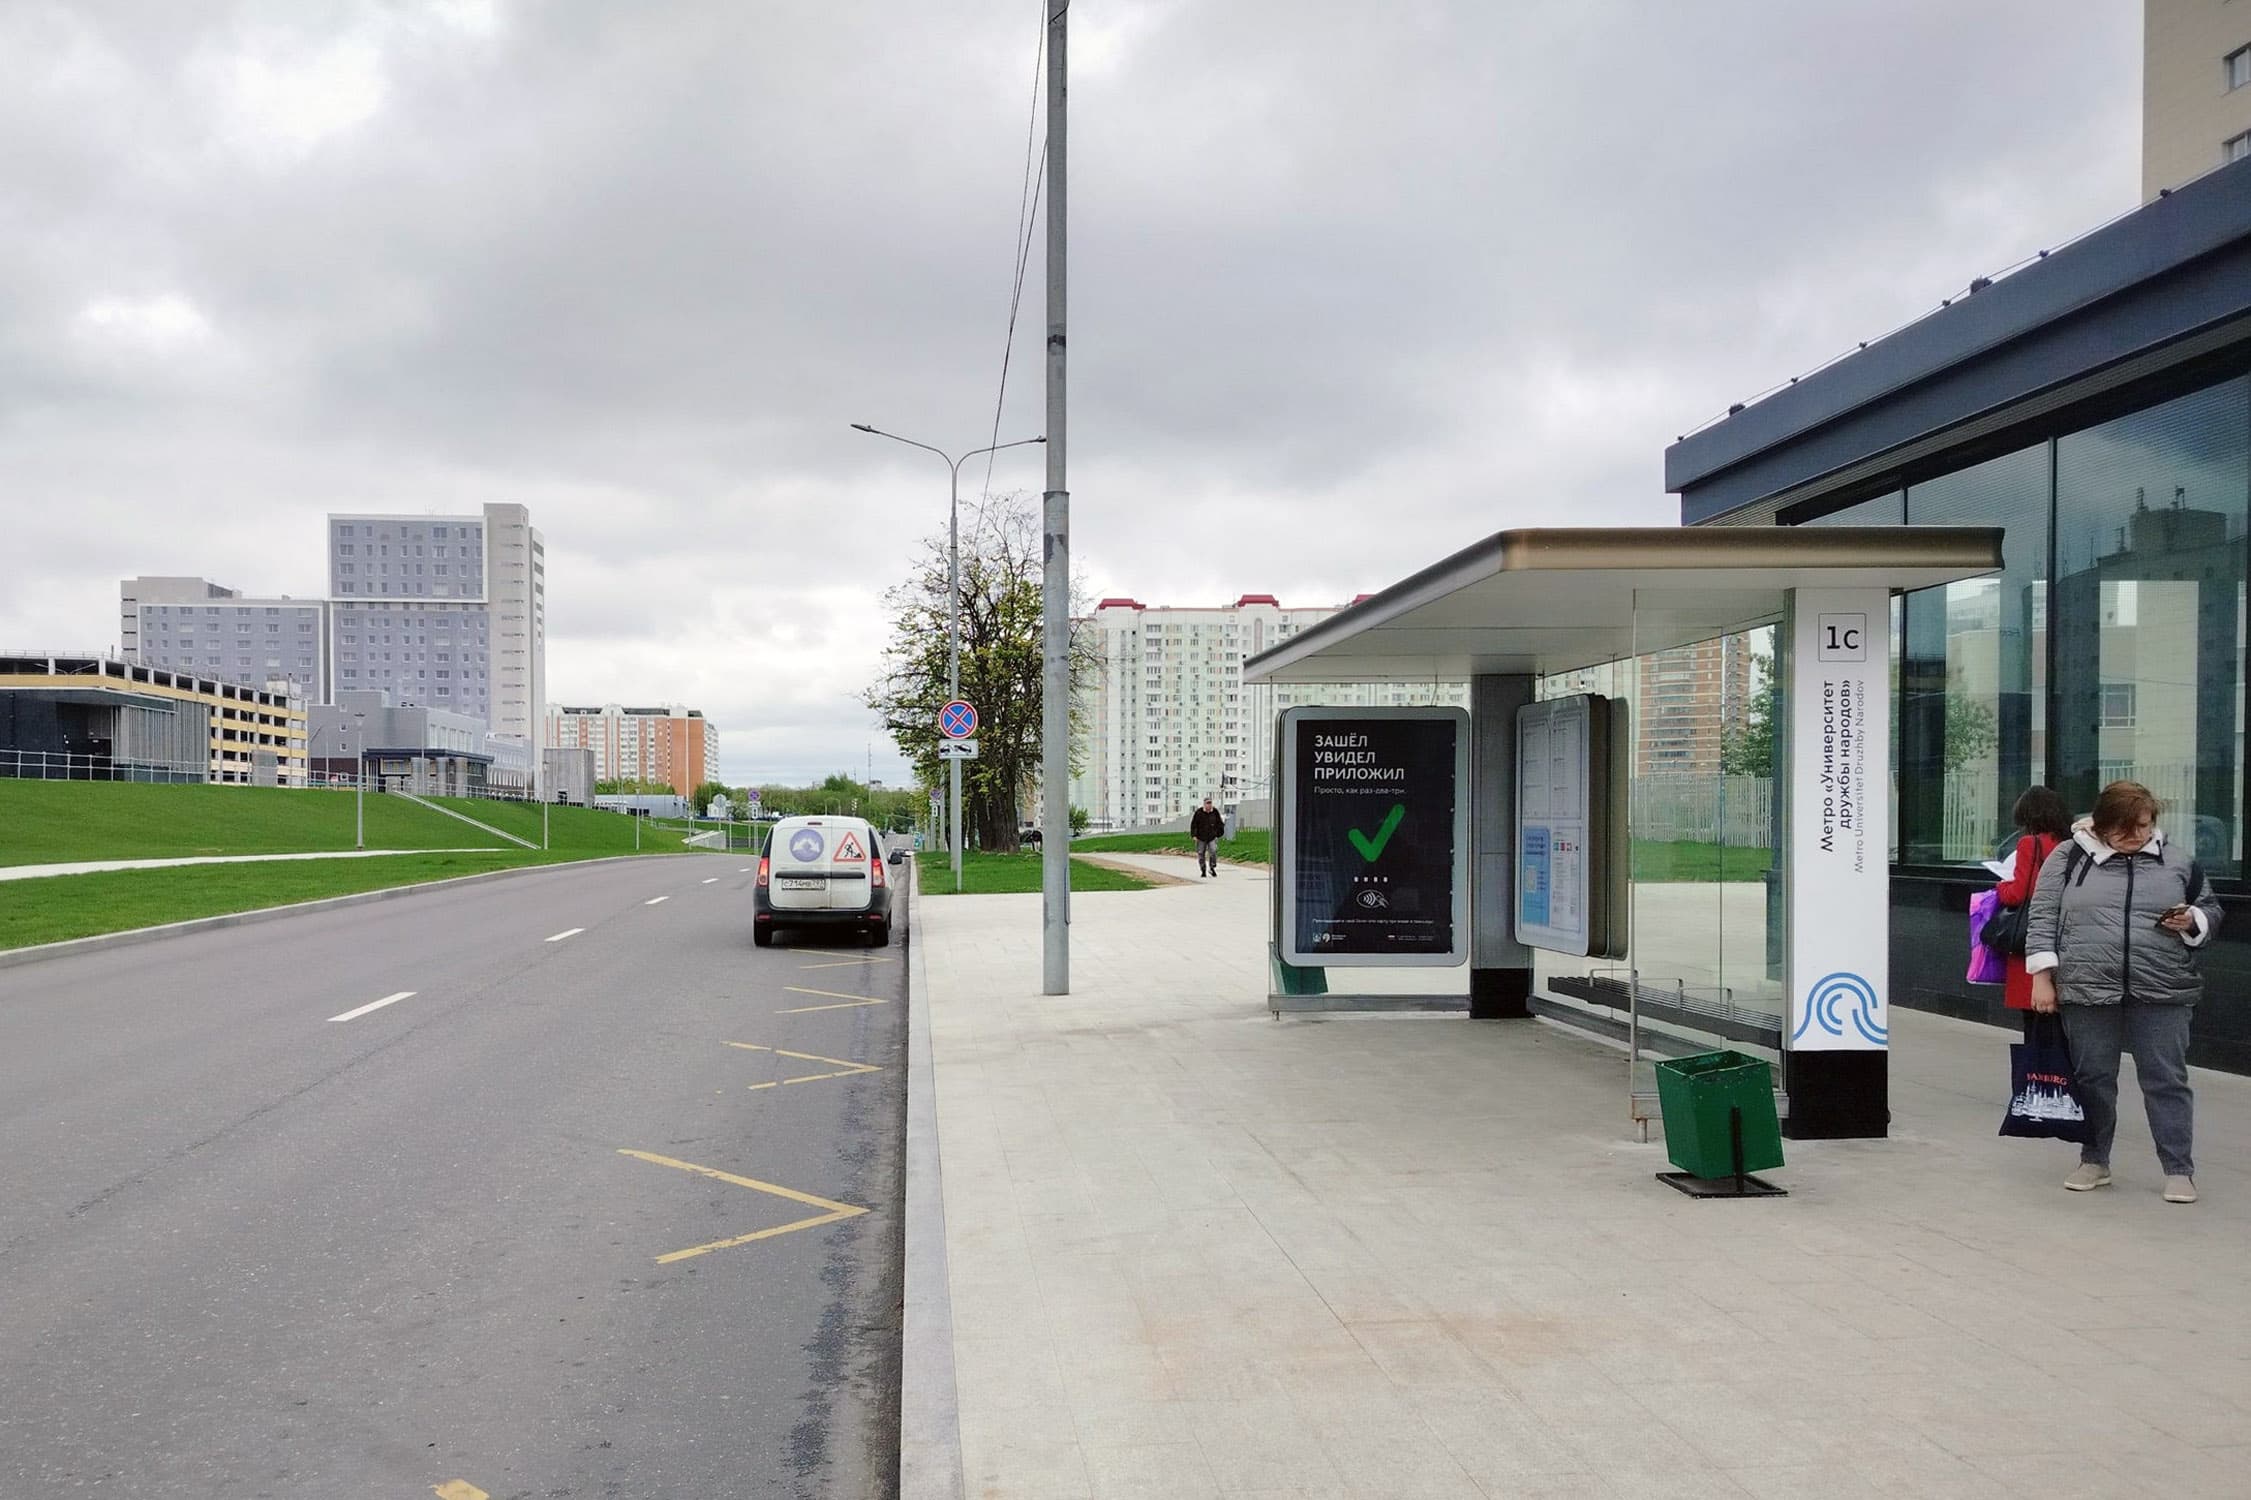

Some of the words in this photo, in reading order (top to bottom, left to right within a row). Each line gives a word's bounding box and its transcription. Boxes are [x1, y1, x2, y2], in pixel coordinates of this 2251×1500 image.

[1838, 680, 1853, 757] народов»
[1854, 680, 1864, 726] Narodov
[1314, 732, 1368, 747] ЗАШЁЛ
[1314, 751, 1376, 765] УВИДЕЛ
[1820, 680, 1836, 793] «Университет
[1854, 730, 1866, 774] Druzhby
[1314, 767, 1405, 780] ПРИЛОЖИЛ
[1314, 786, 1344, 794] Просто,
[1837, 763, 1853, 829] дружбы
[1820, 797, 1836, 852] Метро
[1854, 777, 1864, 837] Universitet
[1854, 840, 1864, 873] Metro
